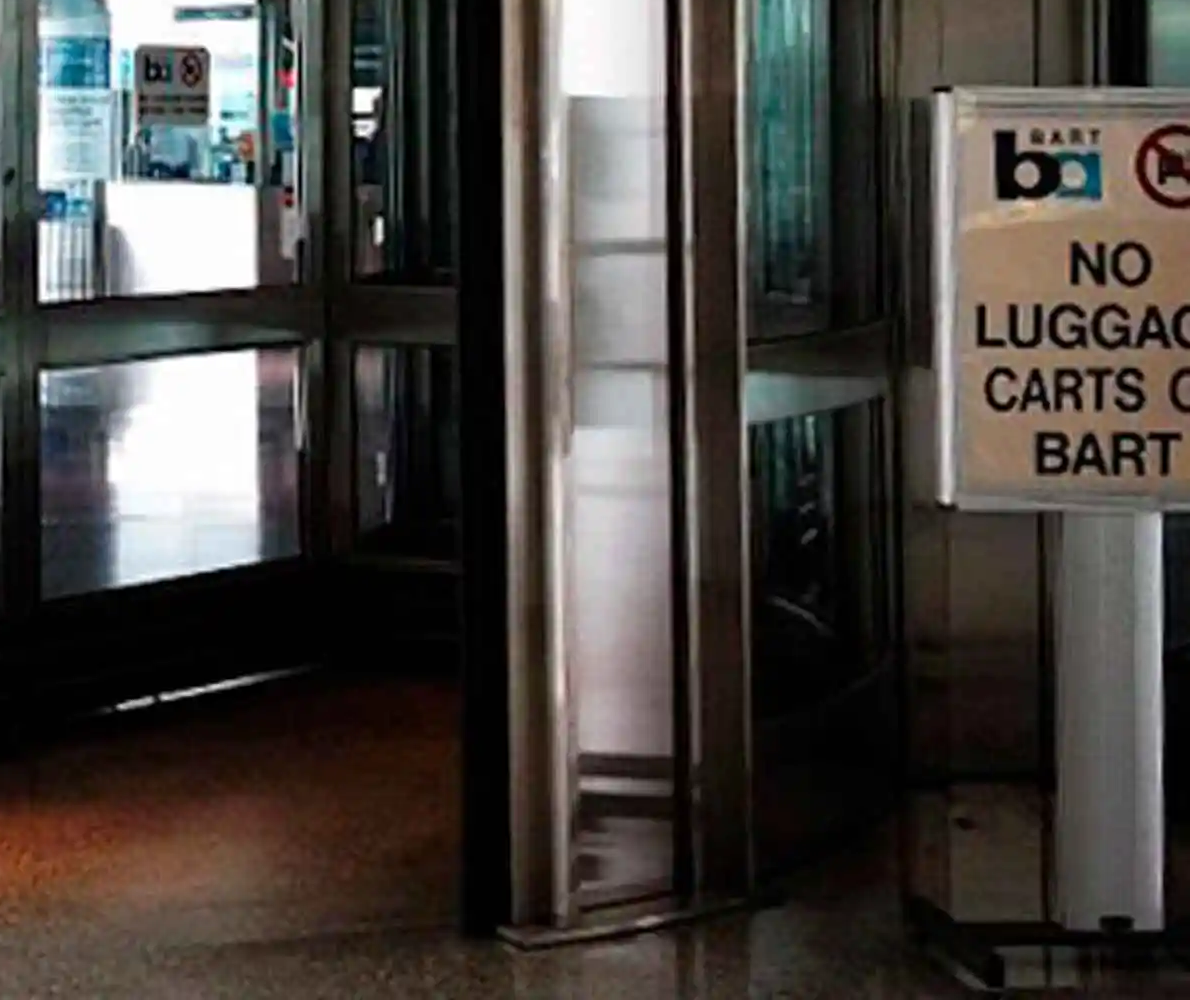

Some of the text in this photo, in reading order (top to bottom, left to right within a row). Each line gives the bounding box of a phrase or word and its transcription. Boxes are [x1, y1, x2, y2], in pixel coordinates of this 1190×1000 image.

[1029, 126, 1102, 145] BART
[1070, 241, 1152, 287] NO
[984, 366, 1146, 413] CARTS
[1035, 432, 1182, 476] BART
